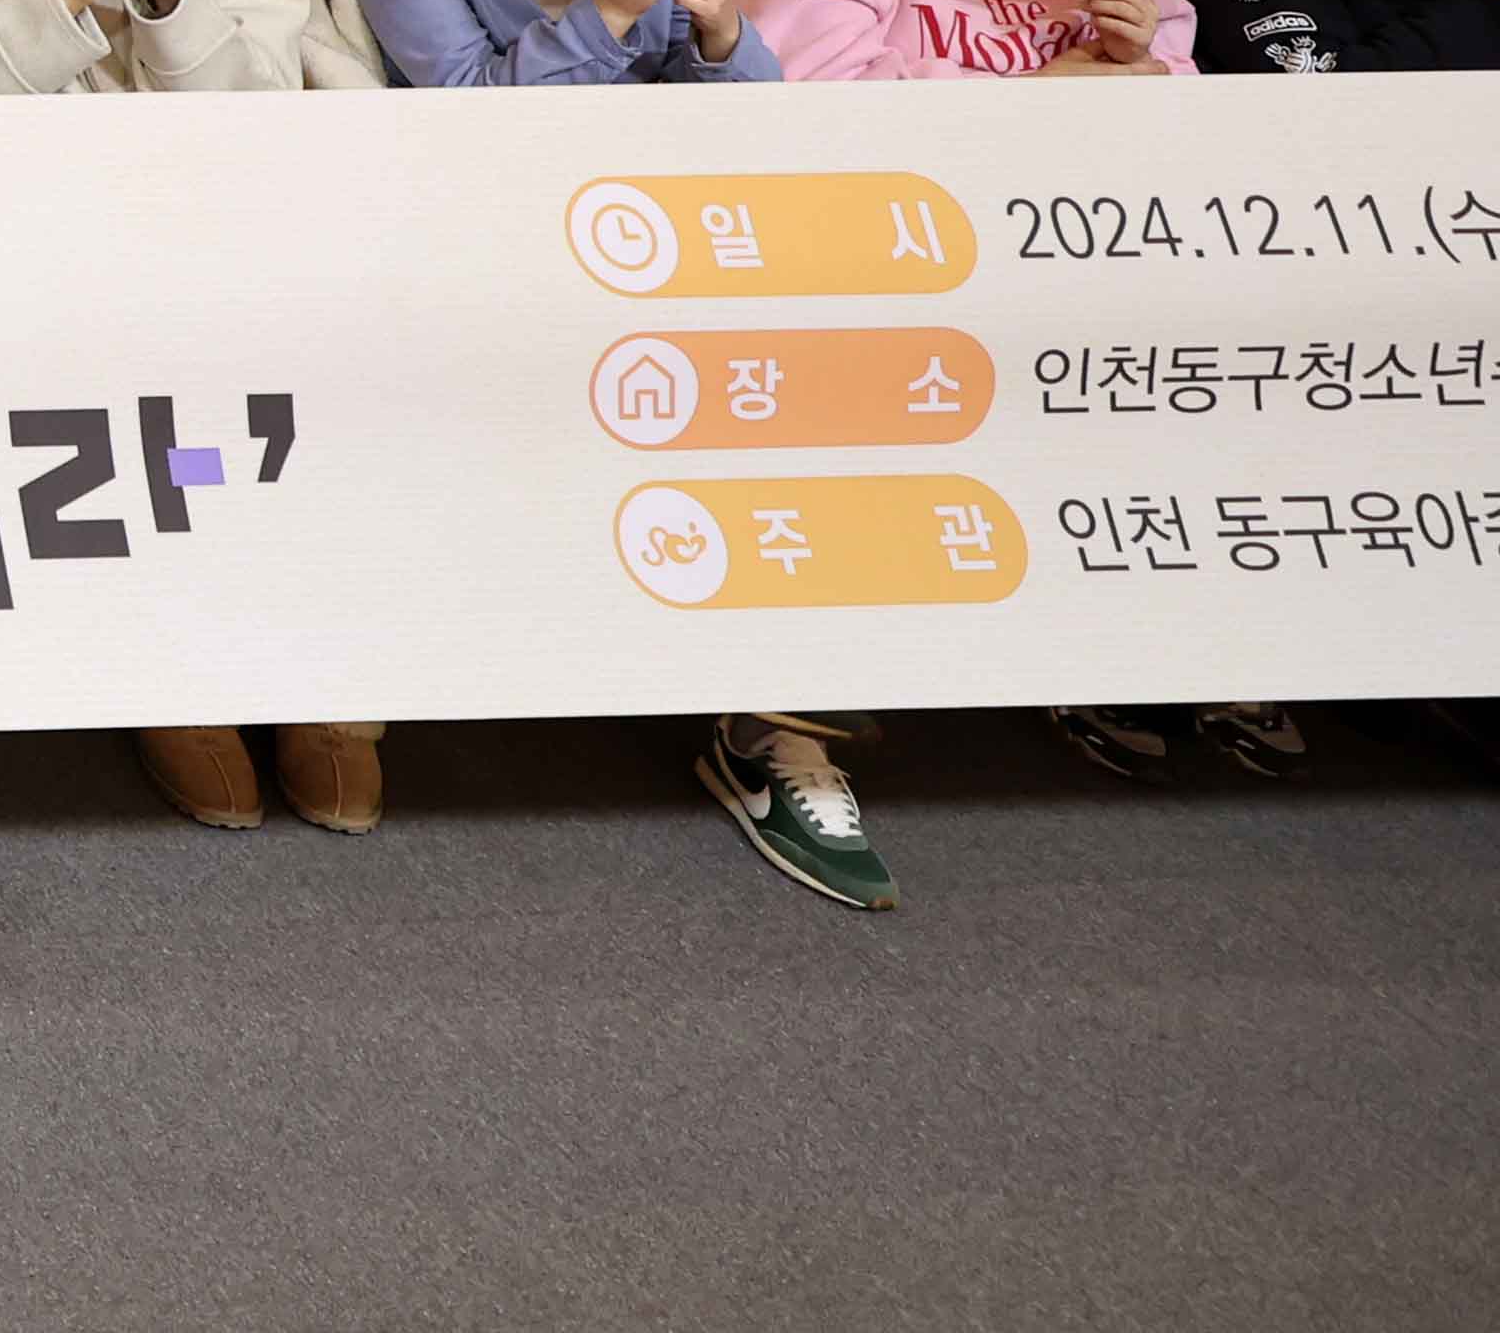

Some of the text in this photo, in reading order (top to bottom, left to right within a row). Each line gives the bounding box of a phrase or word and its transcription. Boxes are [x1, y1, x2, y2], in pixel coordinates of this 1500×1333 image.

[1250, 15, 1310, 37] adidas
[1033, 339, 1500, 416] 인천동구청소년
[1057, 493, 1197, 573] 인천
